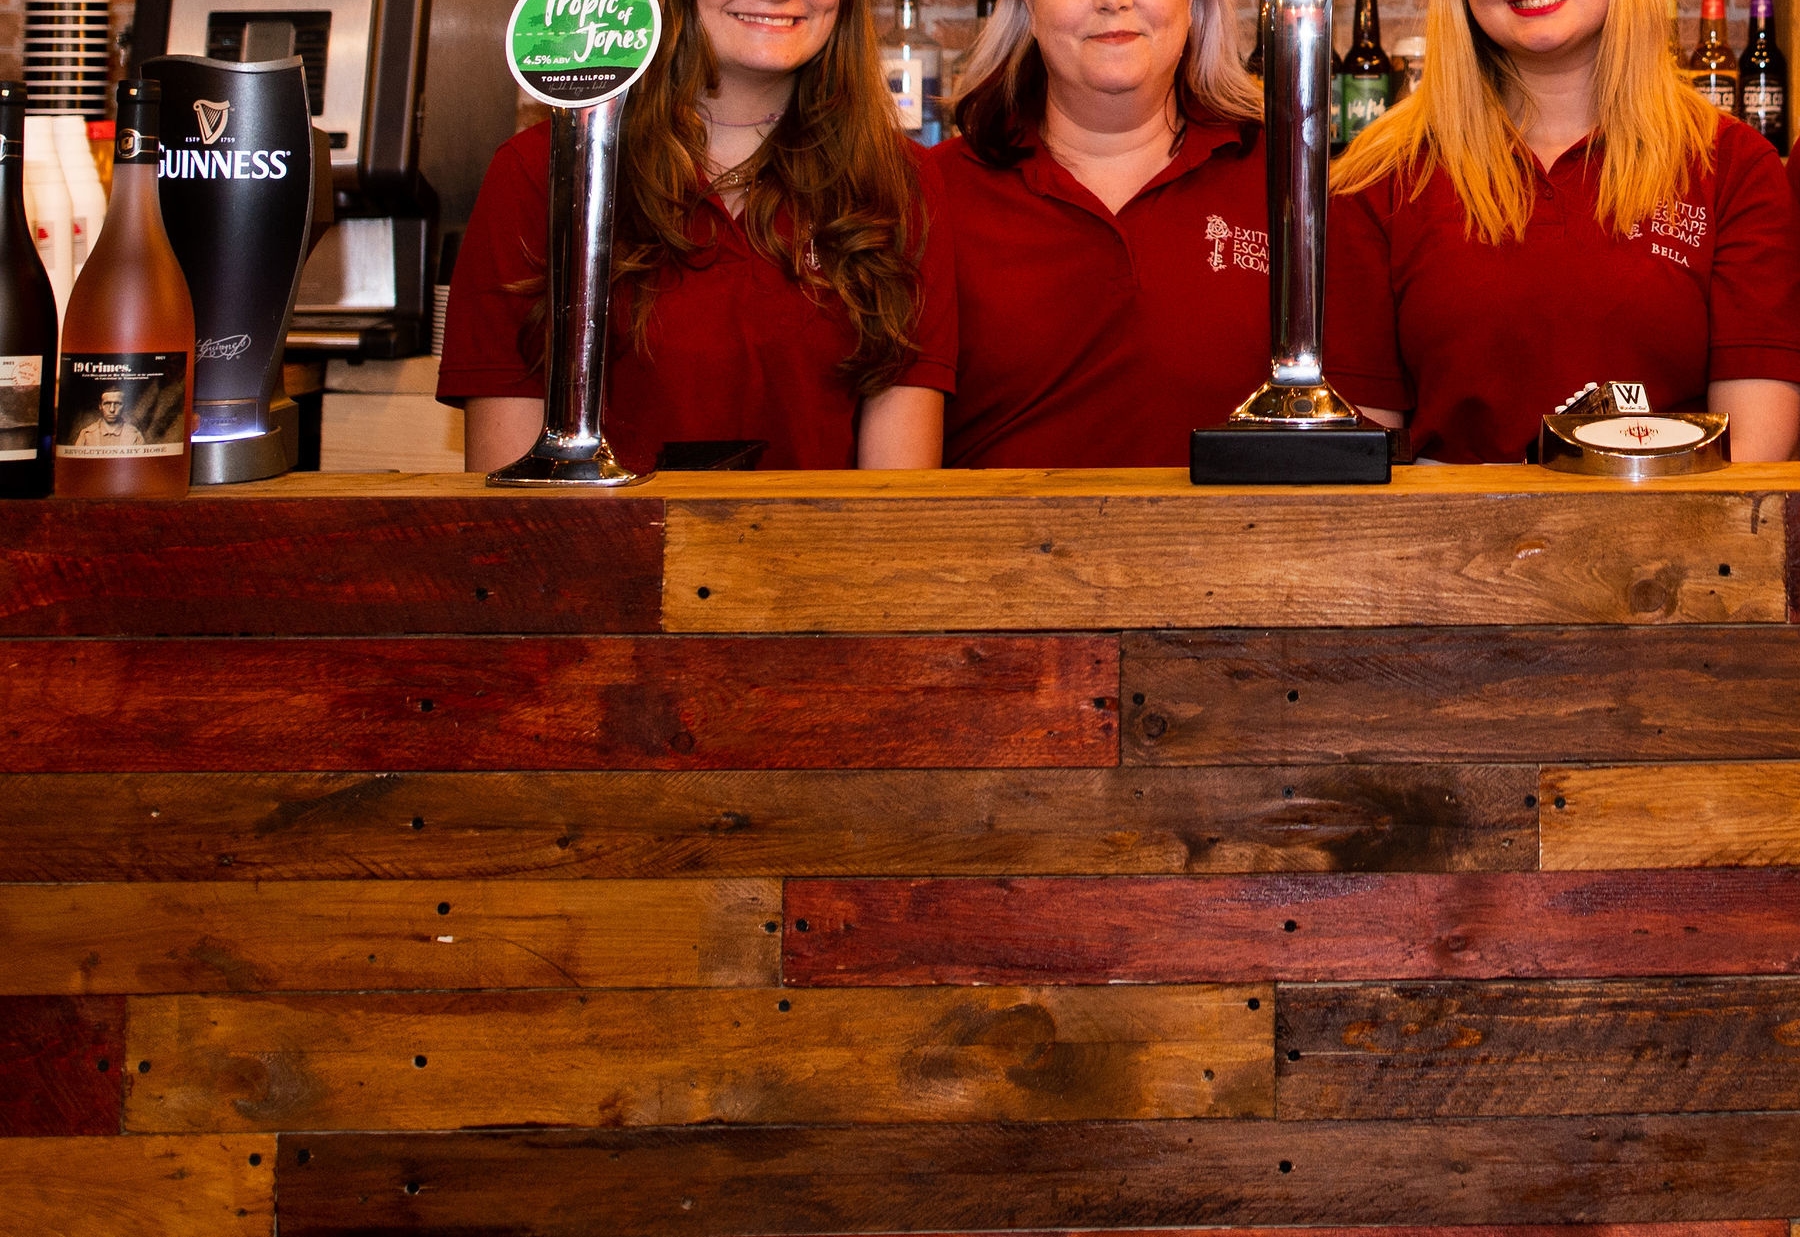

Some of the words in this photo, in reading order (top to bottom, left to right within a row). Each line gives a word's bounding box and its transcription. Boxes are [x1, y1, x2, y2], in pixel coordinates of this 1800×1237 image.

[617, 6, 634, 26] of
[573, 21, 648, 62] Jones
[523, 55, 552, 65] 4.5%
[541, 75, 571, 83] TOMOS
[1653, 209, 1707, 236] ESCAPE
[1234, 226, 1269, 246] EXIT
[1651, 221, 1700, 247] ROOMS
[1233, 239, 1269, 261] ESCA
[1651, 243, 1690, 268] BELLA
[1233, 253, 1269, 275] ROOM
[73, 362, 84, 373] 19
[64, 448, 140, 456] REVOLUTIONARY
